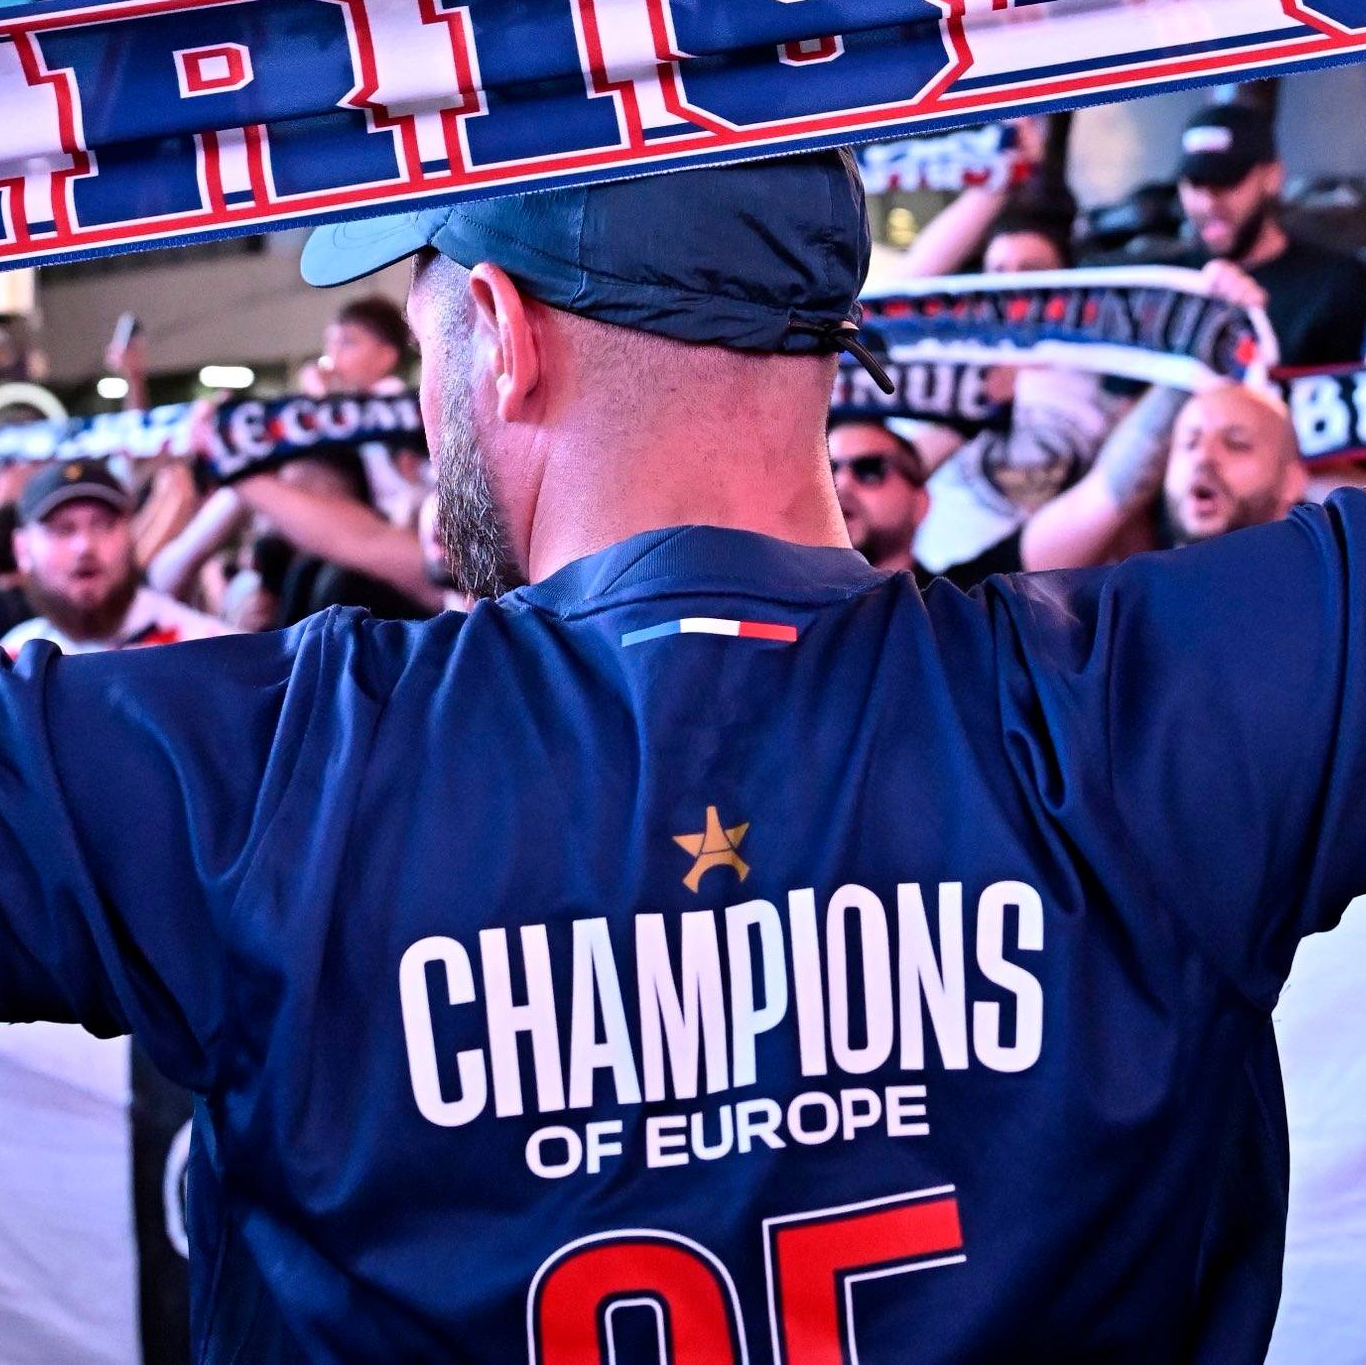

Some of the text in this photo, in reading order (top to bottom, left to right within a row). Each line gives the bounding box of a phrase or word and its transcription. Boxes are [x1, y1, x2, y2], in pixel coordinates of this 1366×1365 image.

[399, 880, 1044, 1127] CHAMPIONS
[524, 1084, 931, 1179] OF EUROPE
